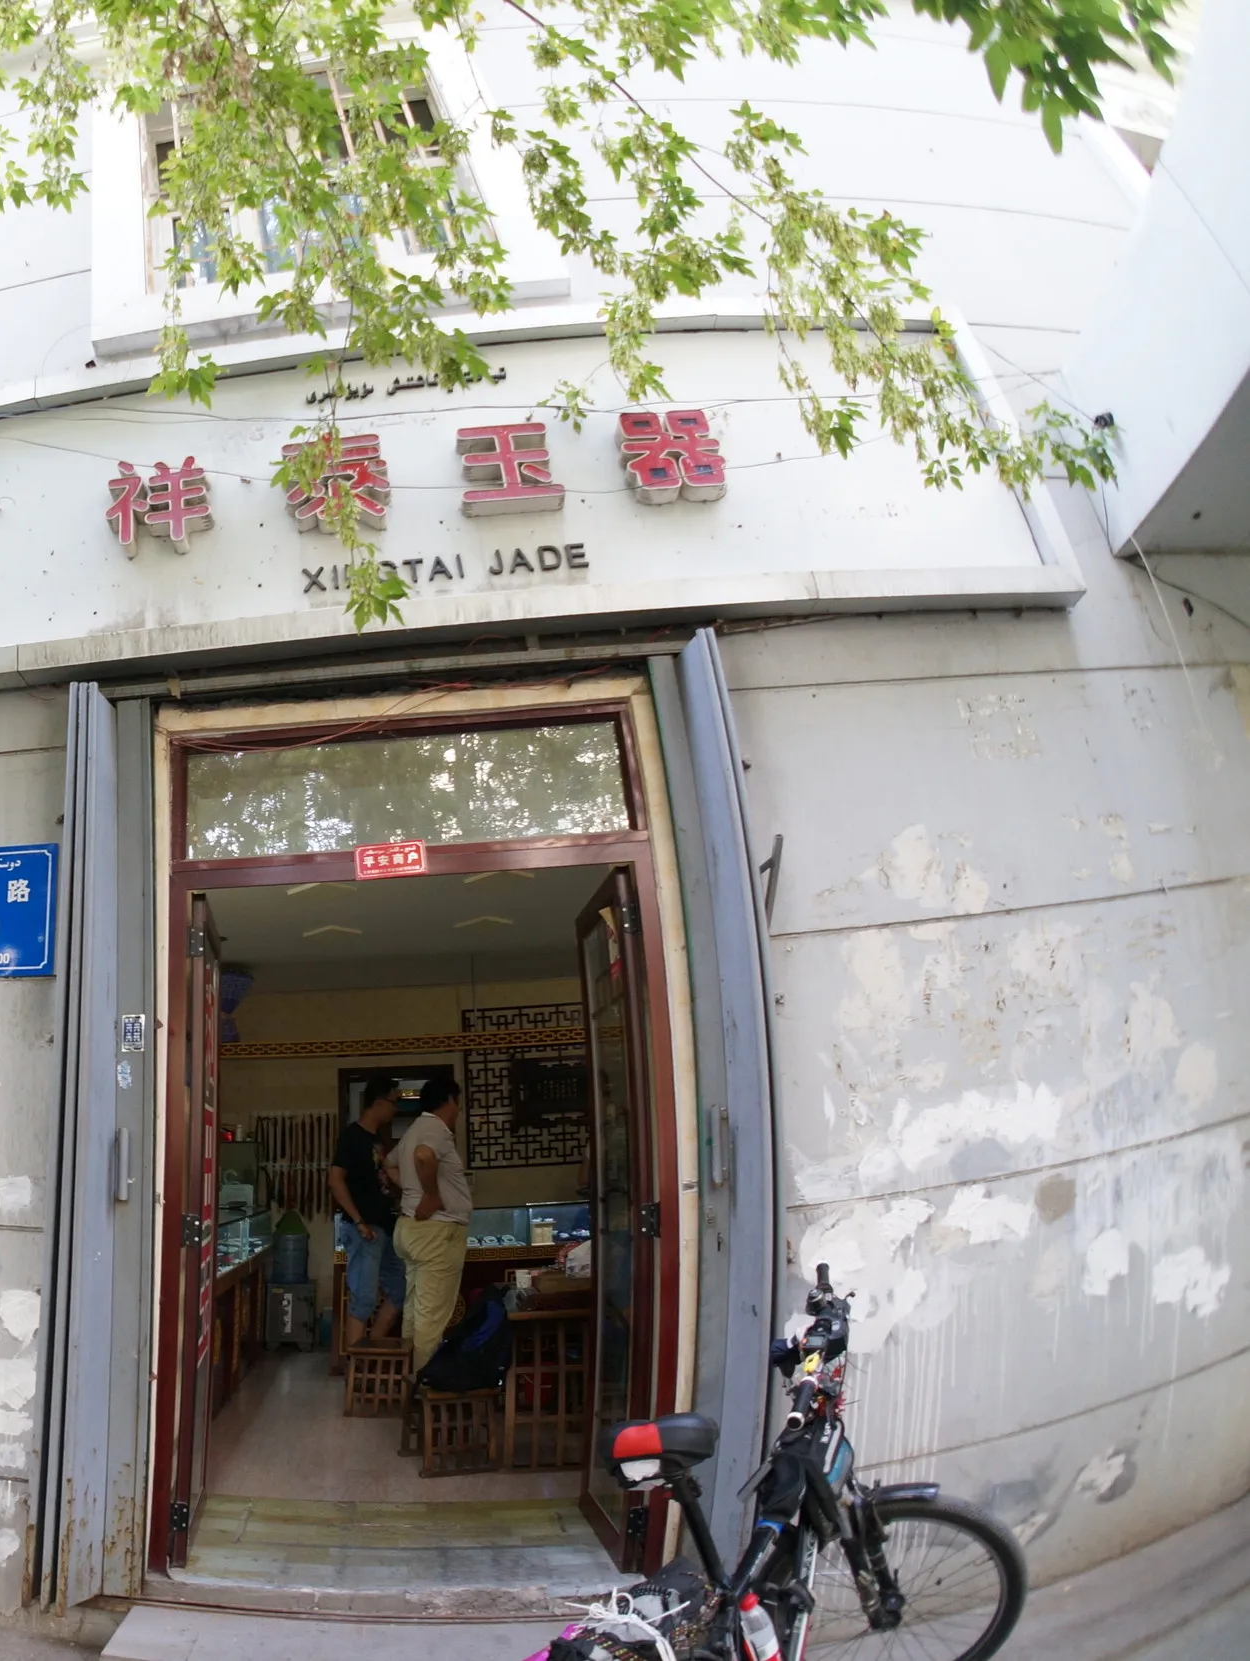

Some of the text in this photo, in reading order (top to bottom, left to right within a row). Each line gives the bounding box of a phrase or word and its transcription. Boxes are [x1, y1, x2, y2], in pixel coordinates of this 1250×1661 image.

[105, 410, 726, 548] 祥泰玉器
[302, 543, 590, 594] XITAI JADE
